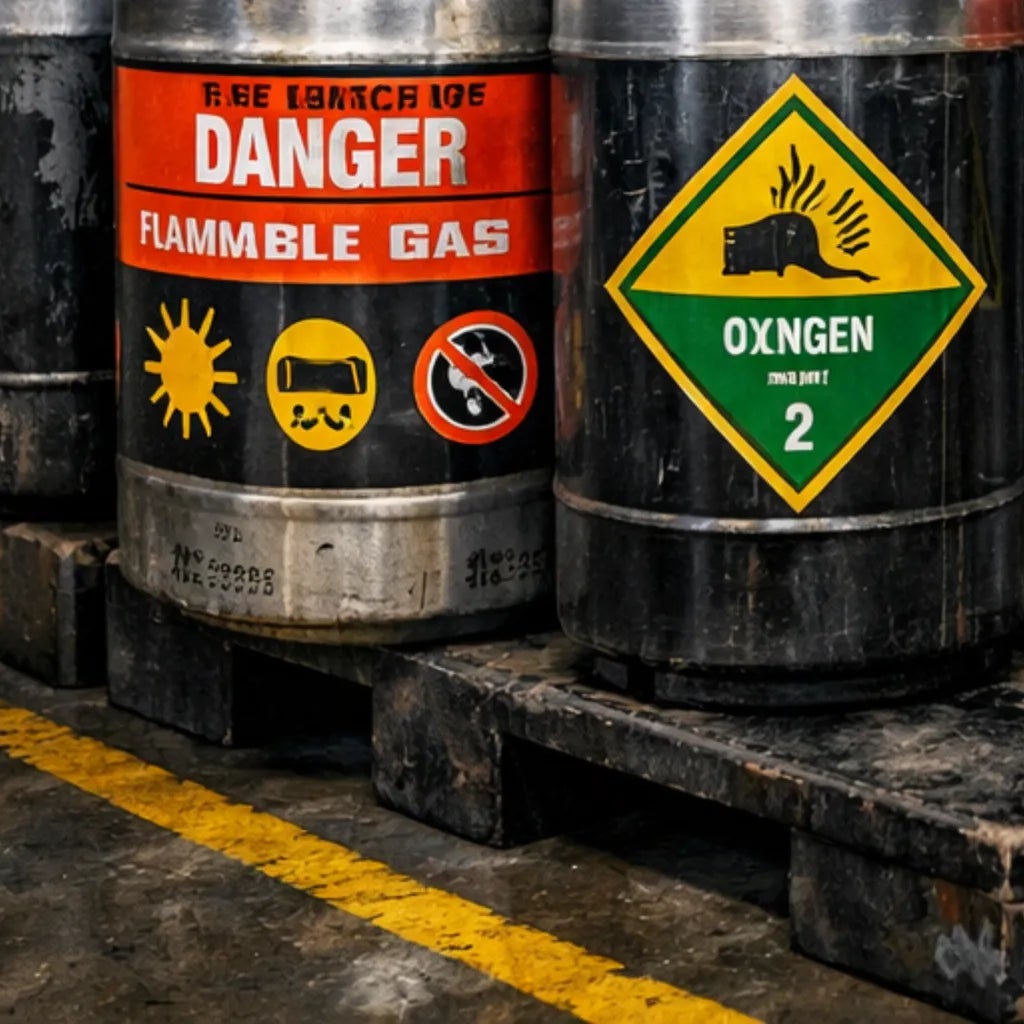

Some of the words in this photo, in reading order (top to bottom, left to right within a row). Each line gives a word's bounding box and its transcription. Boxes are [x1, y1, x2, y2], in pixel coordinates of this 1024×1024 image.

[194, 113, 468, 190] DANGER
[139, 208, 361, 261] FLAMMBLE
[389, 218, 510, 261] GAS
[722, 315, 874, 356] OXNGEN
[784, 402, 814, 452] 2
